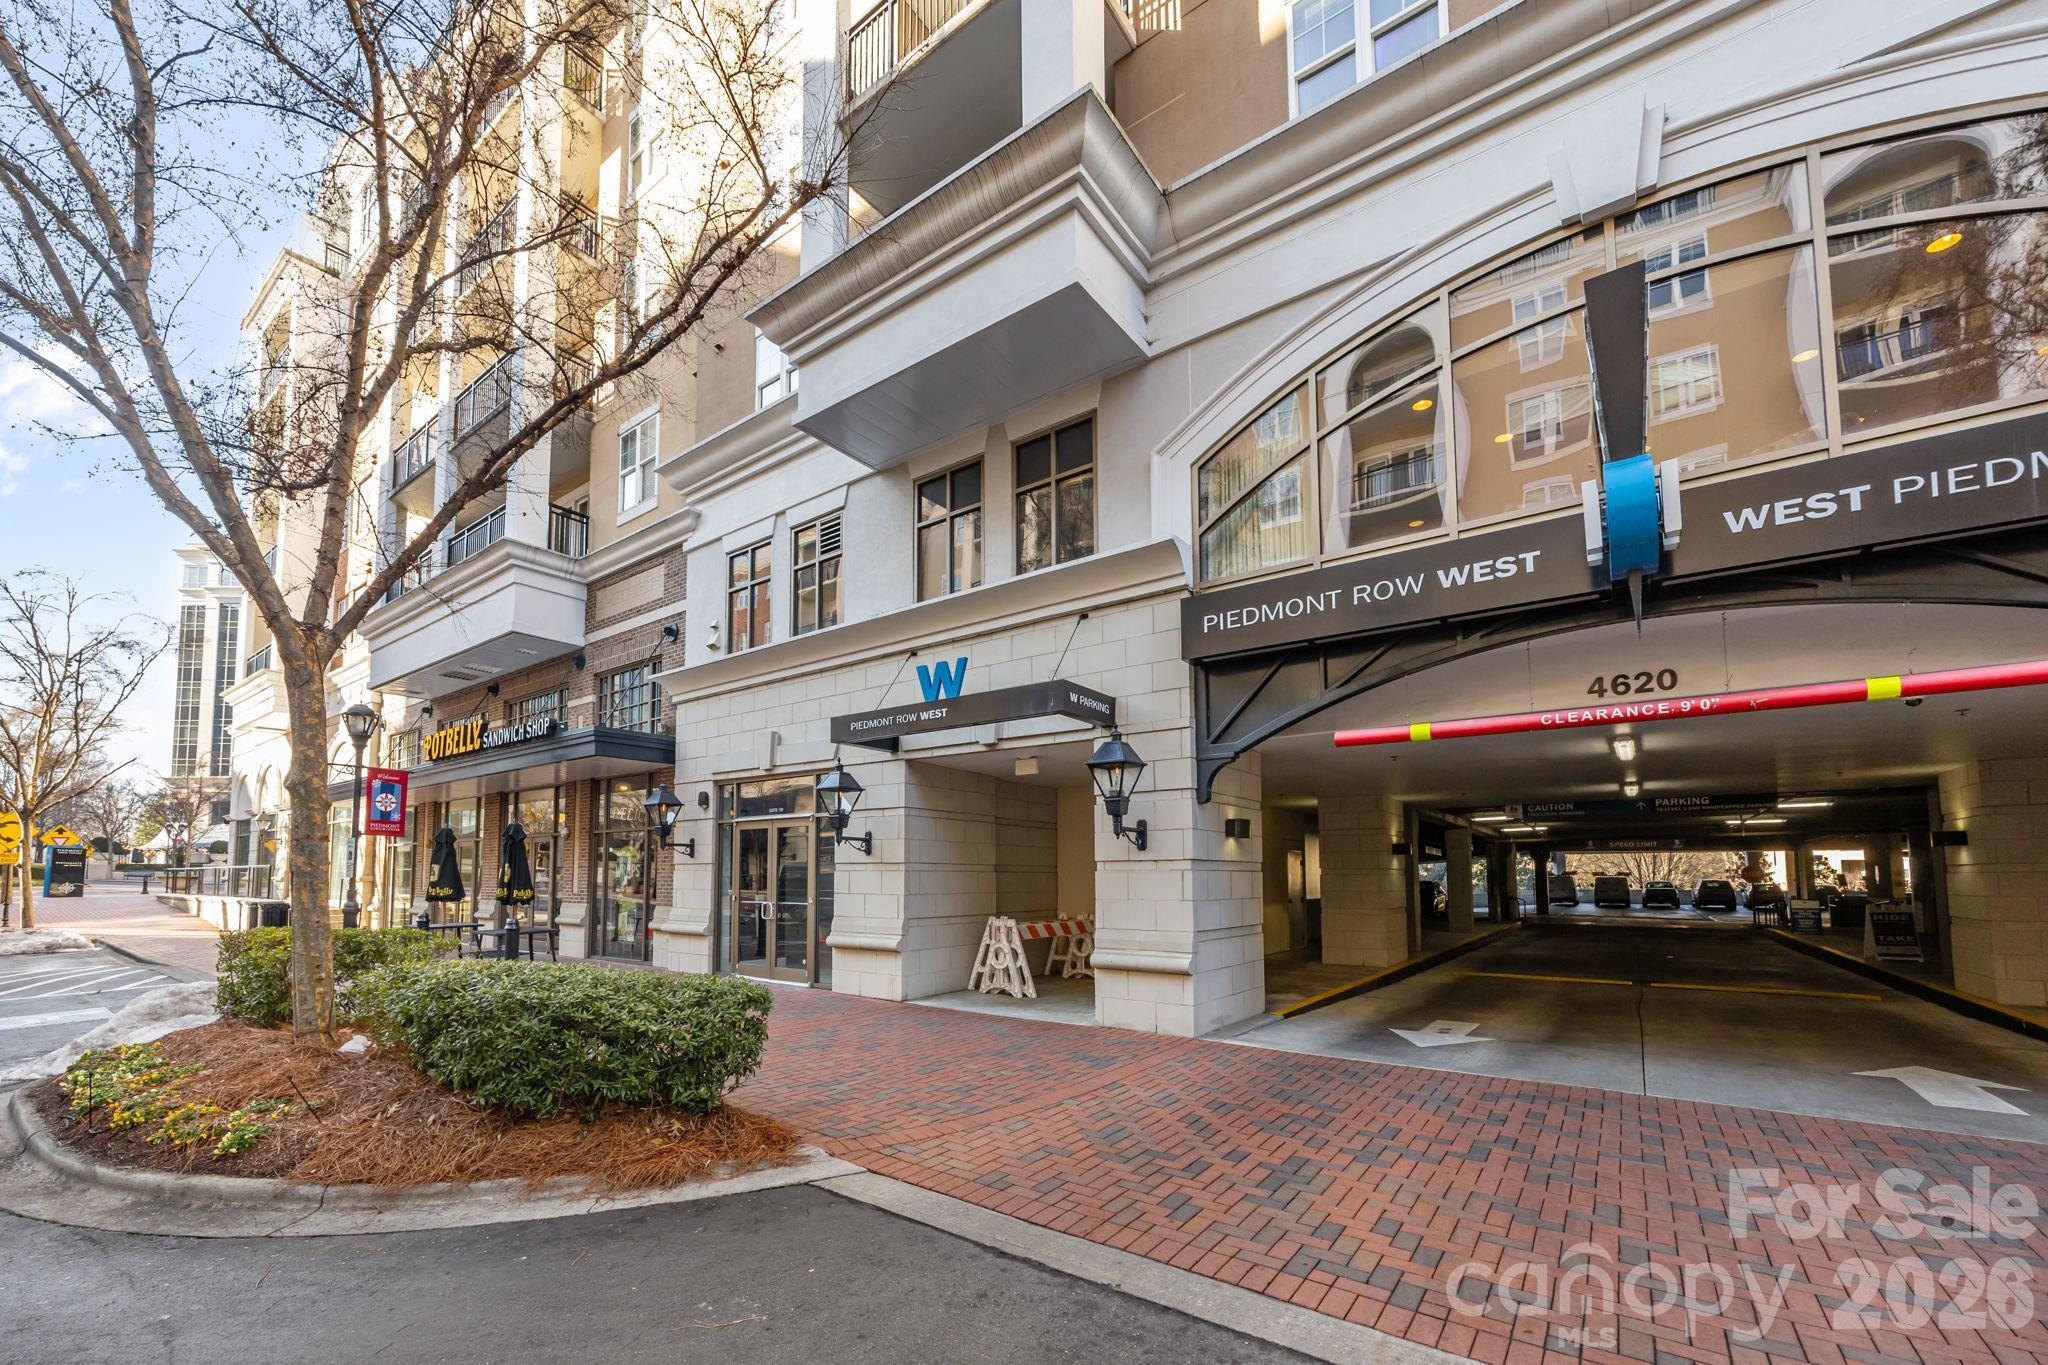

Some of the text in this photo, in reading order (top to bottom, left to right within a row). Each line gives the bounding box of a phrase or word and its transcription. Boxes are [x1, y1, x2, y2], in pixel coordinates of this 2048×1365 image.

[1722, 484, 1871, 533] WEST
[1203, 550, 1541, 633] PIEDMONT ROW WEST
[916, 656, 968, 702] W
[1587, 668, 1678, 698] 4620
[1070, 691, 1110, 714] W PARKING
[1540, 702, 1669, 725] CLEARANCE
[850, 708, 948, 731] PIEDMONT ROW WEST
[423, 717, 550, 760] POTBELLY SANDWICH SHOP
[1528, 803, 1574, 811] CAUTION
[1655, 796, 1710, 806] PARKING
